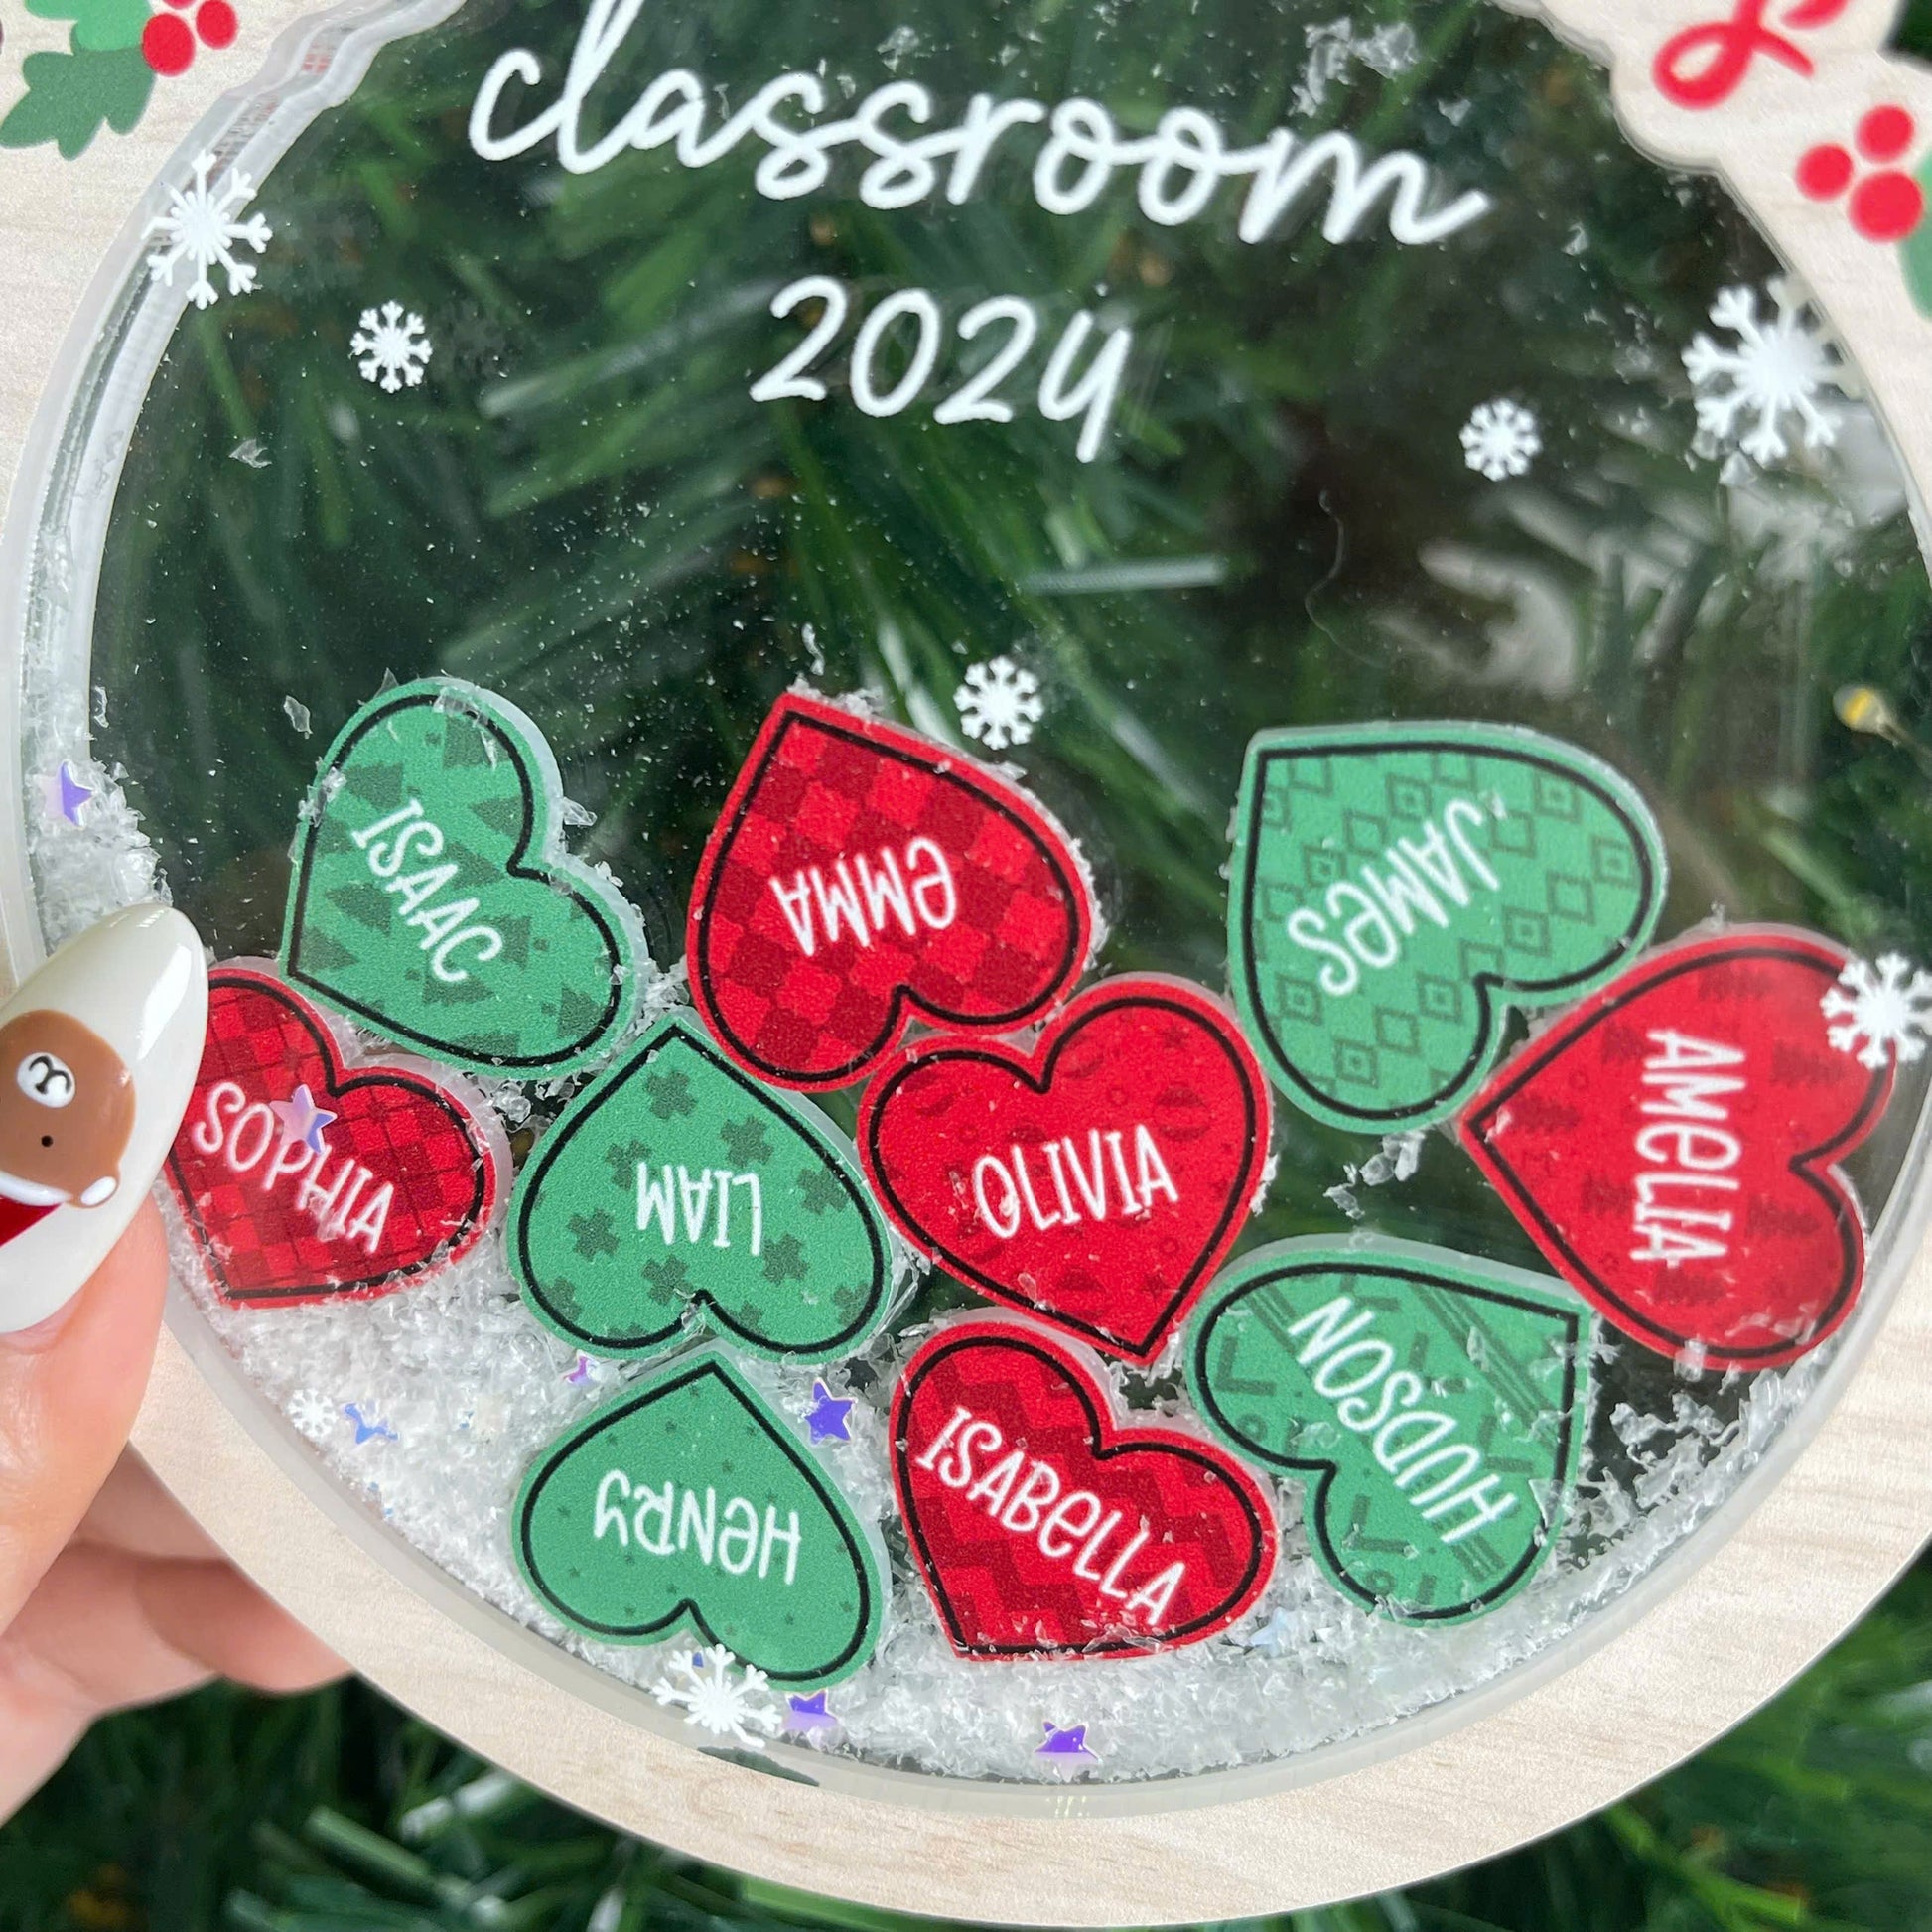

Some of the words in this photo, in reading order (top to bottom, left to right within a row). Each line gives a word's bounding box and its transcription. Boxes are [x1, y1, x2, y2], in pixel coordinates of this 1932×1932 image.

[470, 0, 1489, 245] classroom
[752, 275, 1130, 463] 2024
[351, 800, 502, 982] ISAAC
[193, 1081, 394, 1253] SOPHIA
[635, 1162, 760, 1257] LIAM
[973, 1124, 1178, 1238] OLIVIA
[1288, 1297, 1518, 1544] HUDSON
